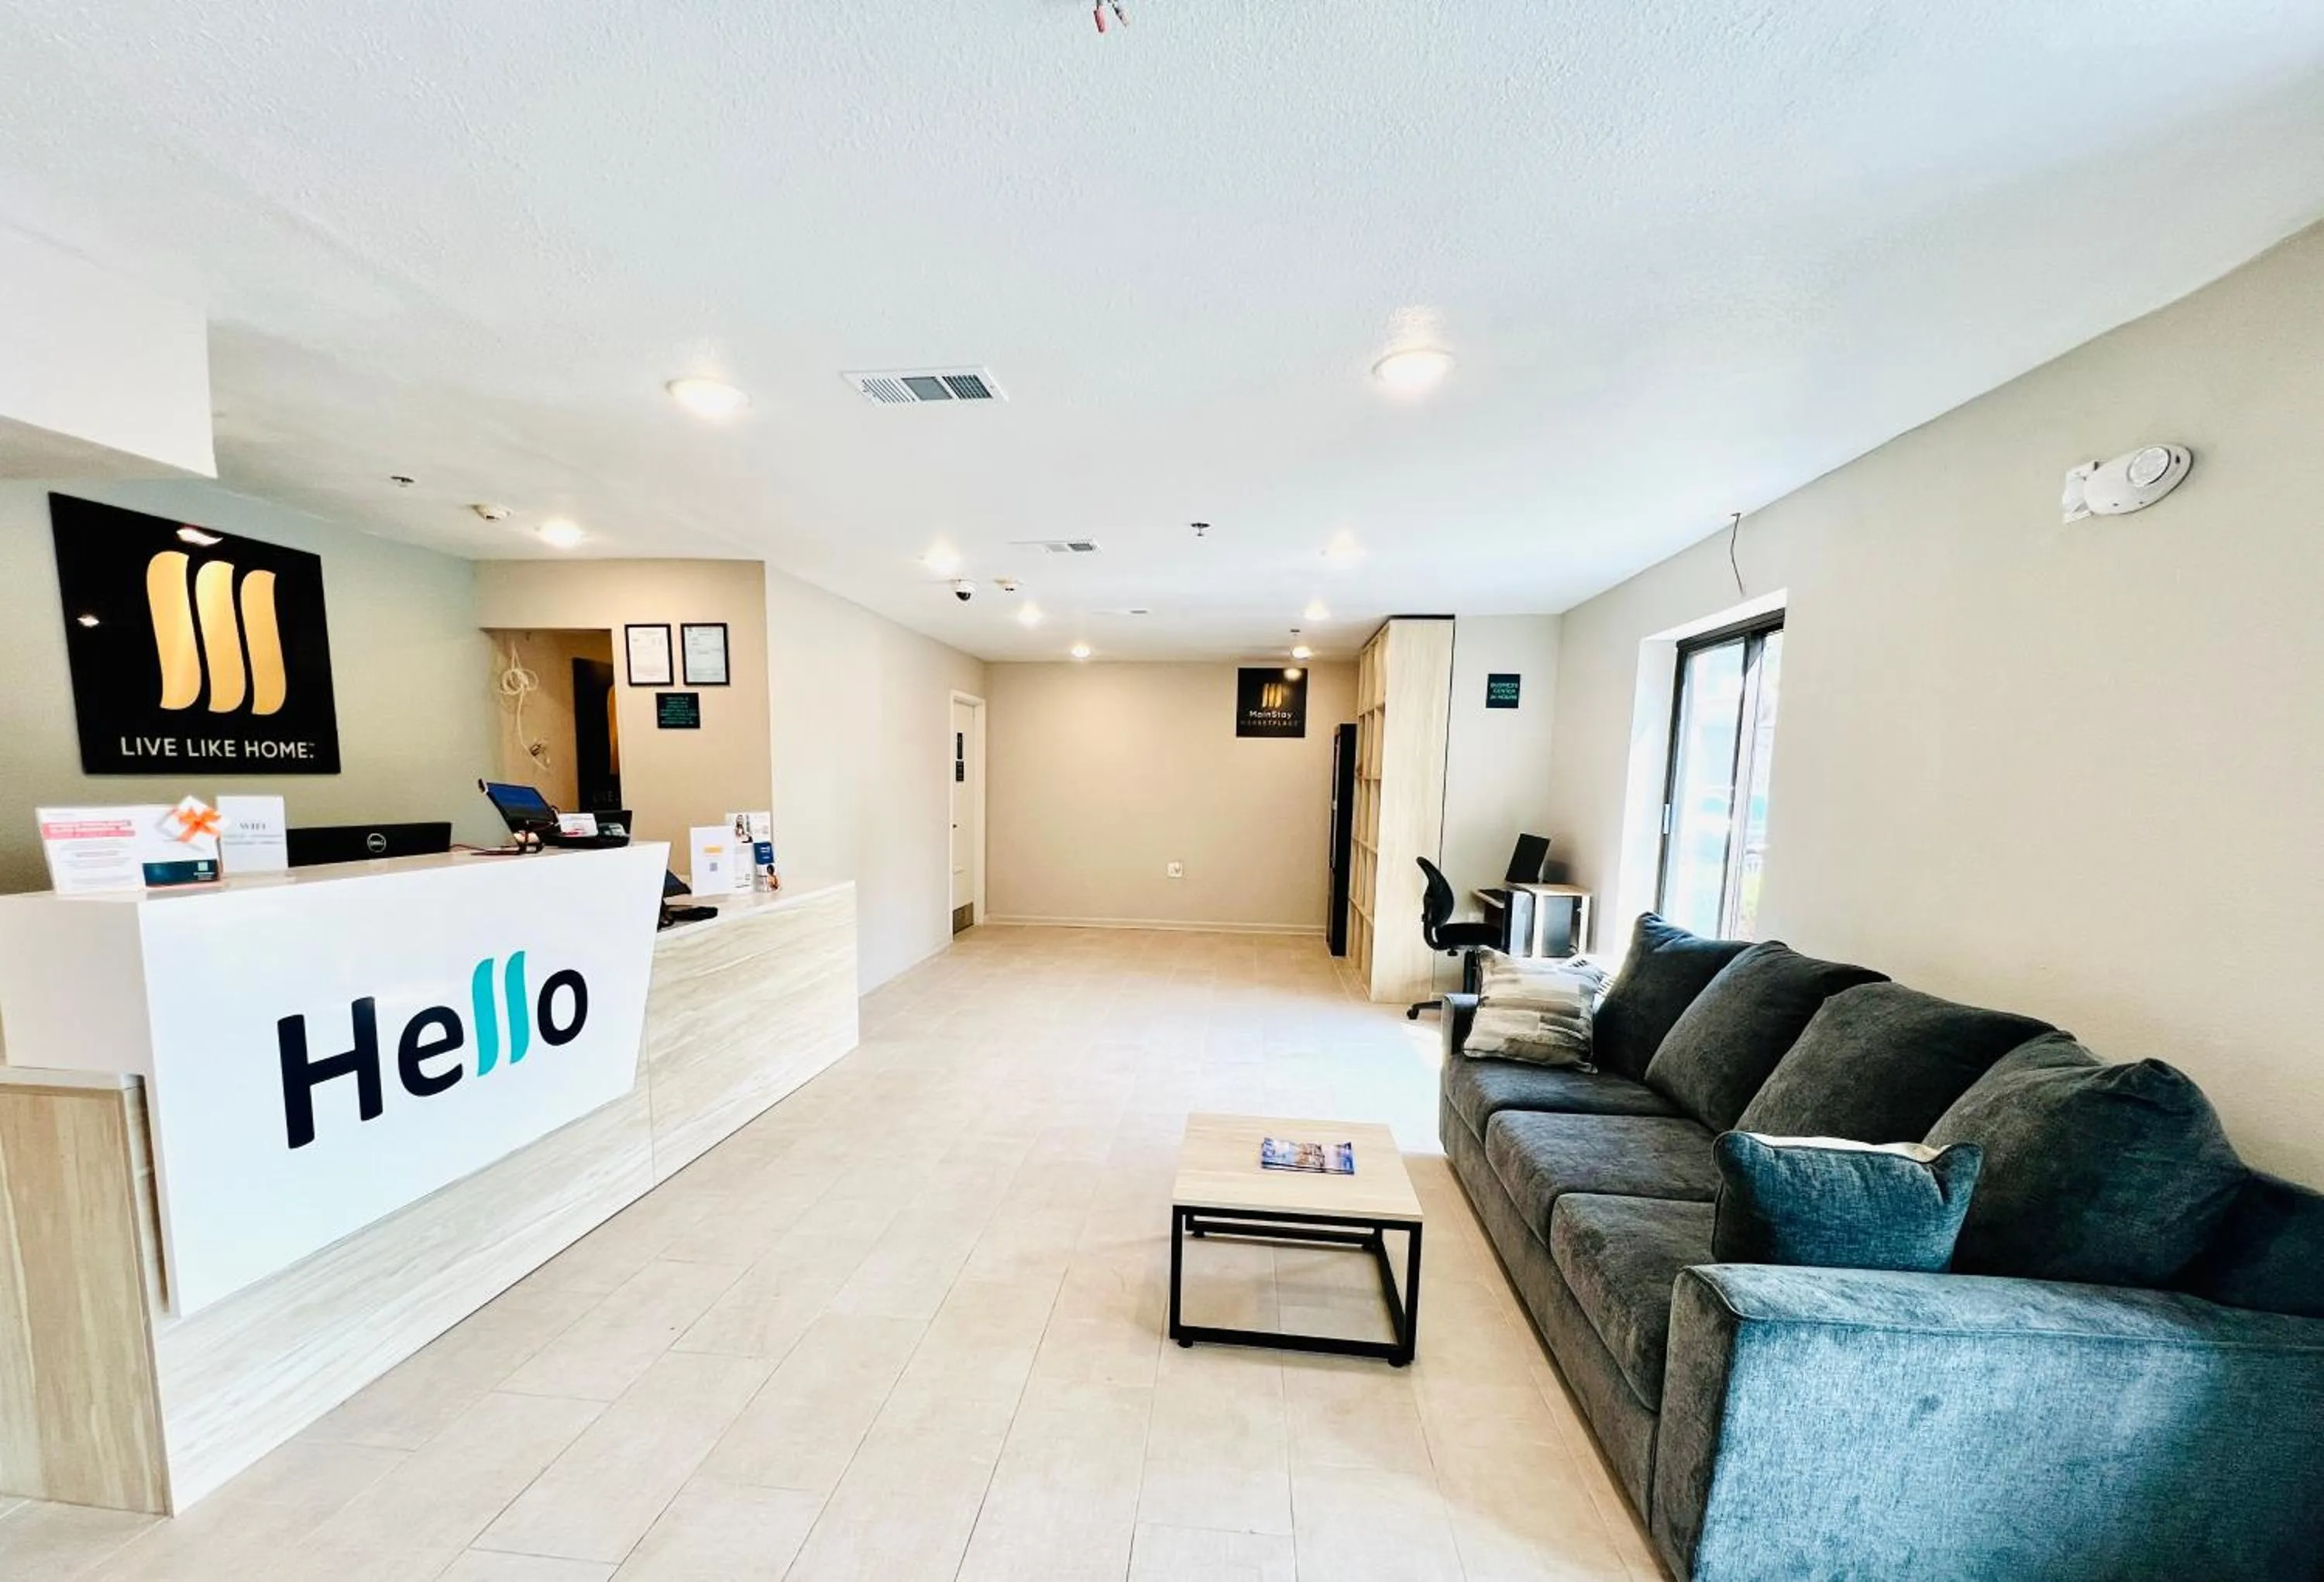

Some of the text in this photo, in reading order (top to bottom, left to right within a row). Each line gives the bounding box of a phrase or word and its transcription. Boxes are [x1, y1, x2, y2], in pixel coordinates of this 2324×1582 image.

[120, 737, 178, 757] LIVE
[187, 738, 236, 758] LIKE
[277, 951, 588, 1149] Hello
